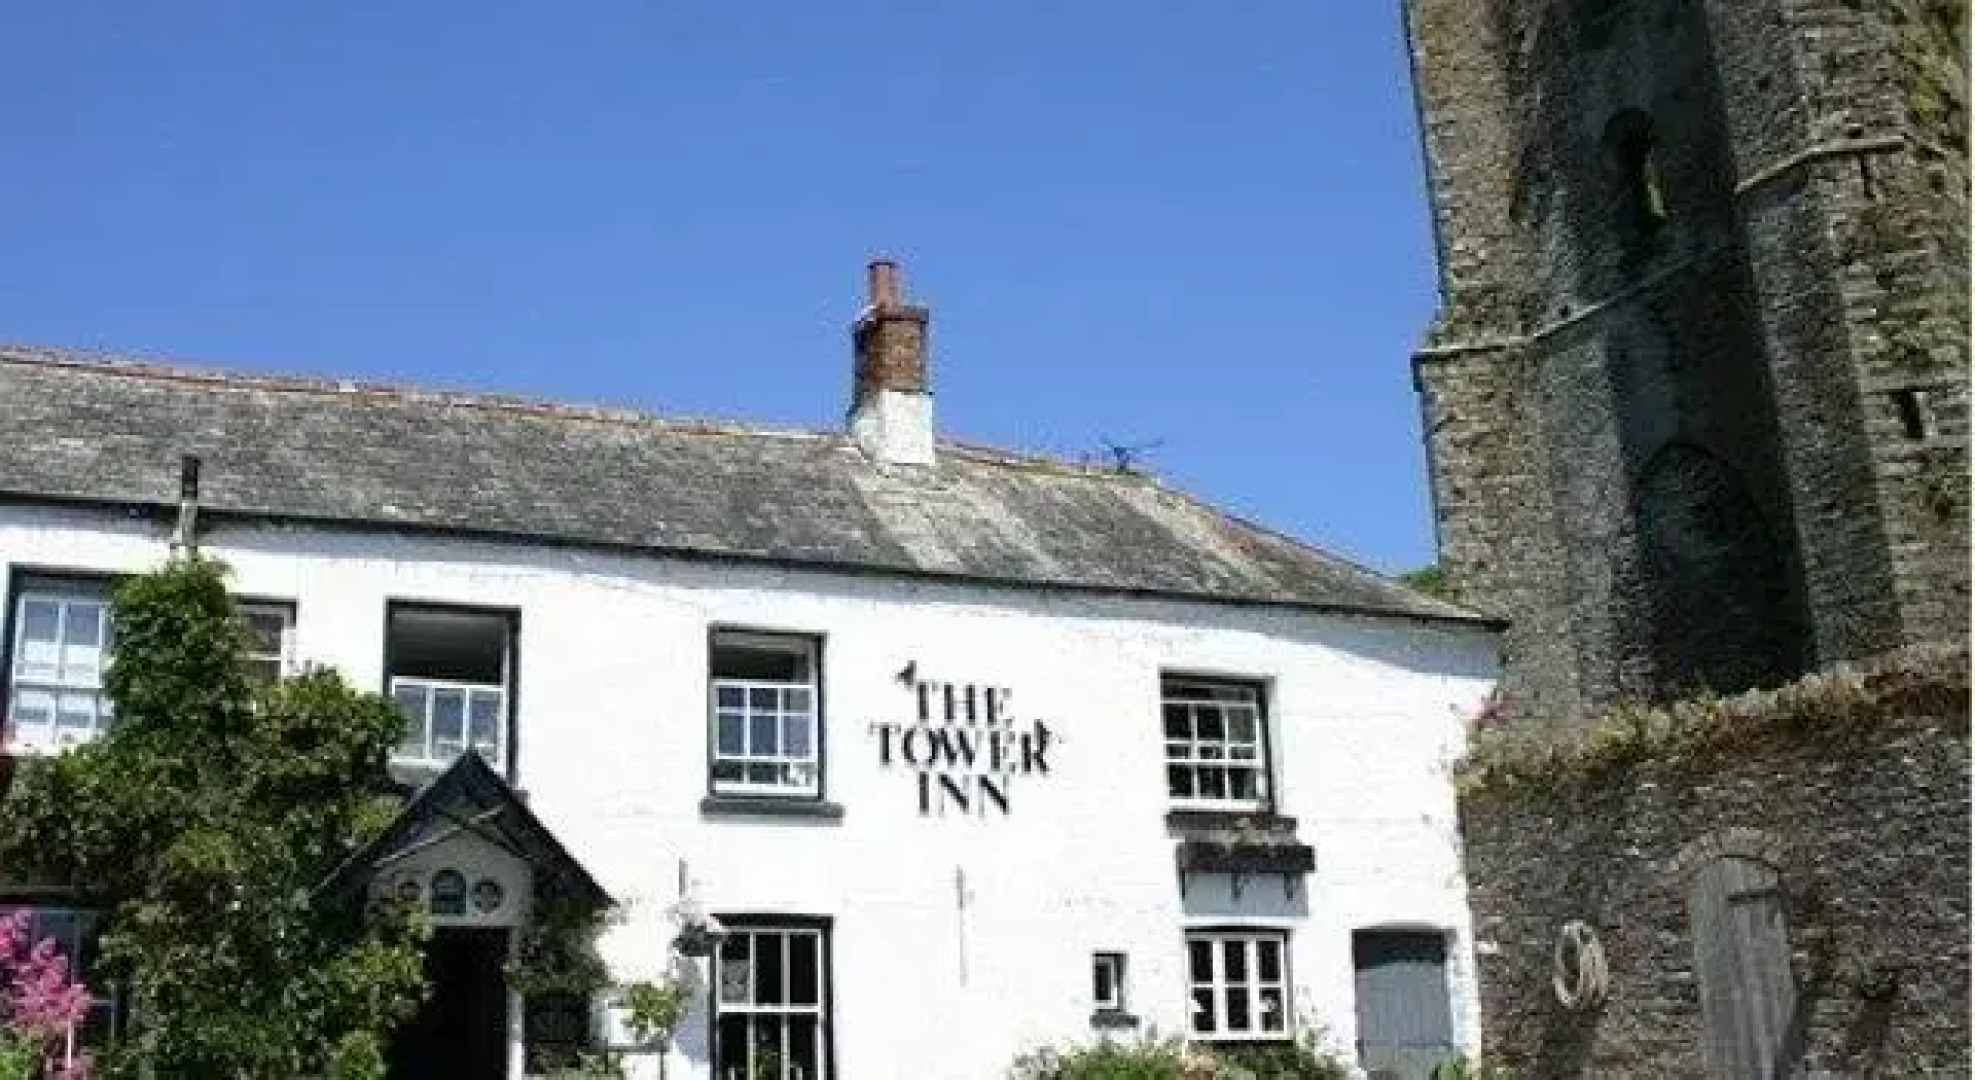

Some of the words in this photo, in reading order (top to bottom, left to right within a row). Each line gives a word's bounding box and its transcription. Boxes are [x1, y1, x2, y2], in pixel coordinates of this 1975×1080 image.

[912, 681, 1013, 726] THE
[868, 721, 1050, 775] TOWER
[917, 770, 1011, 817] INN
